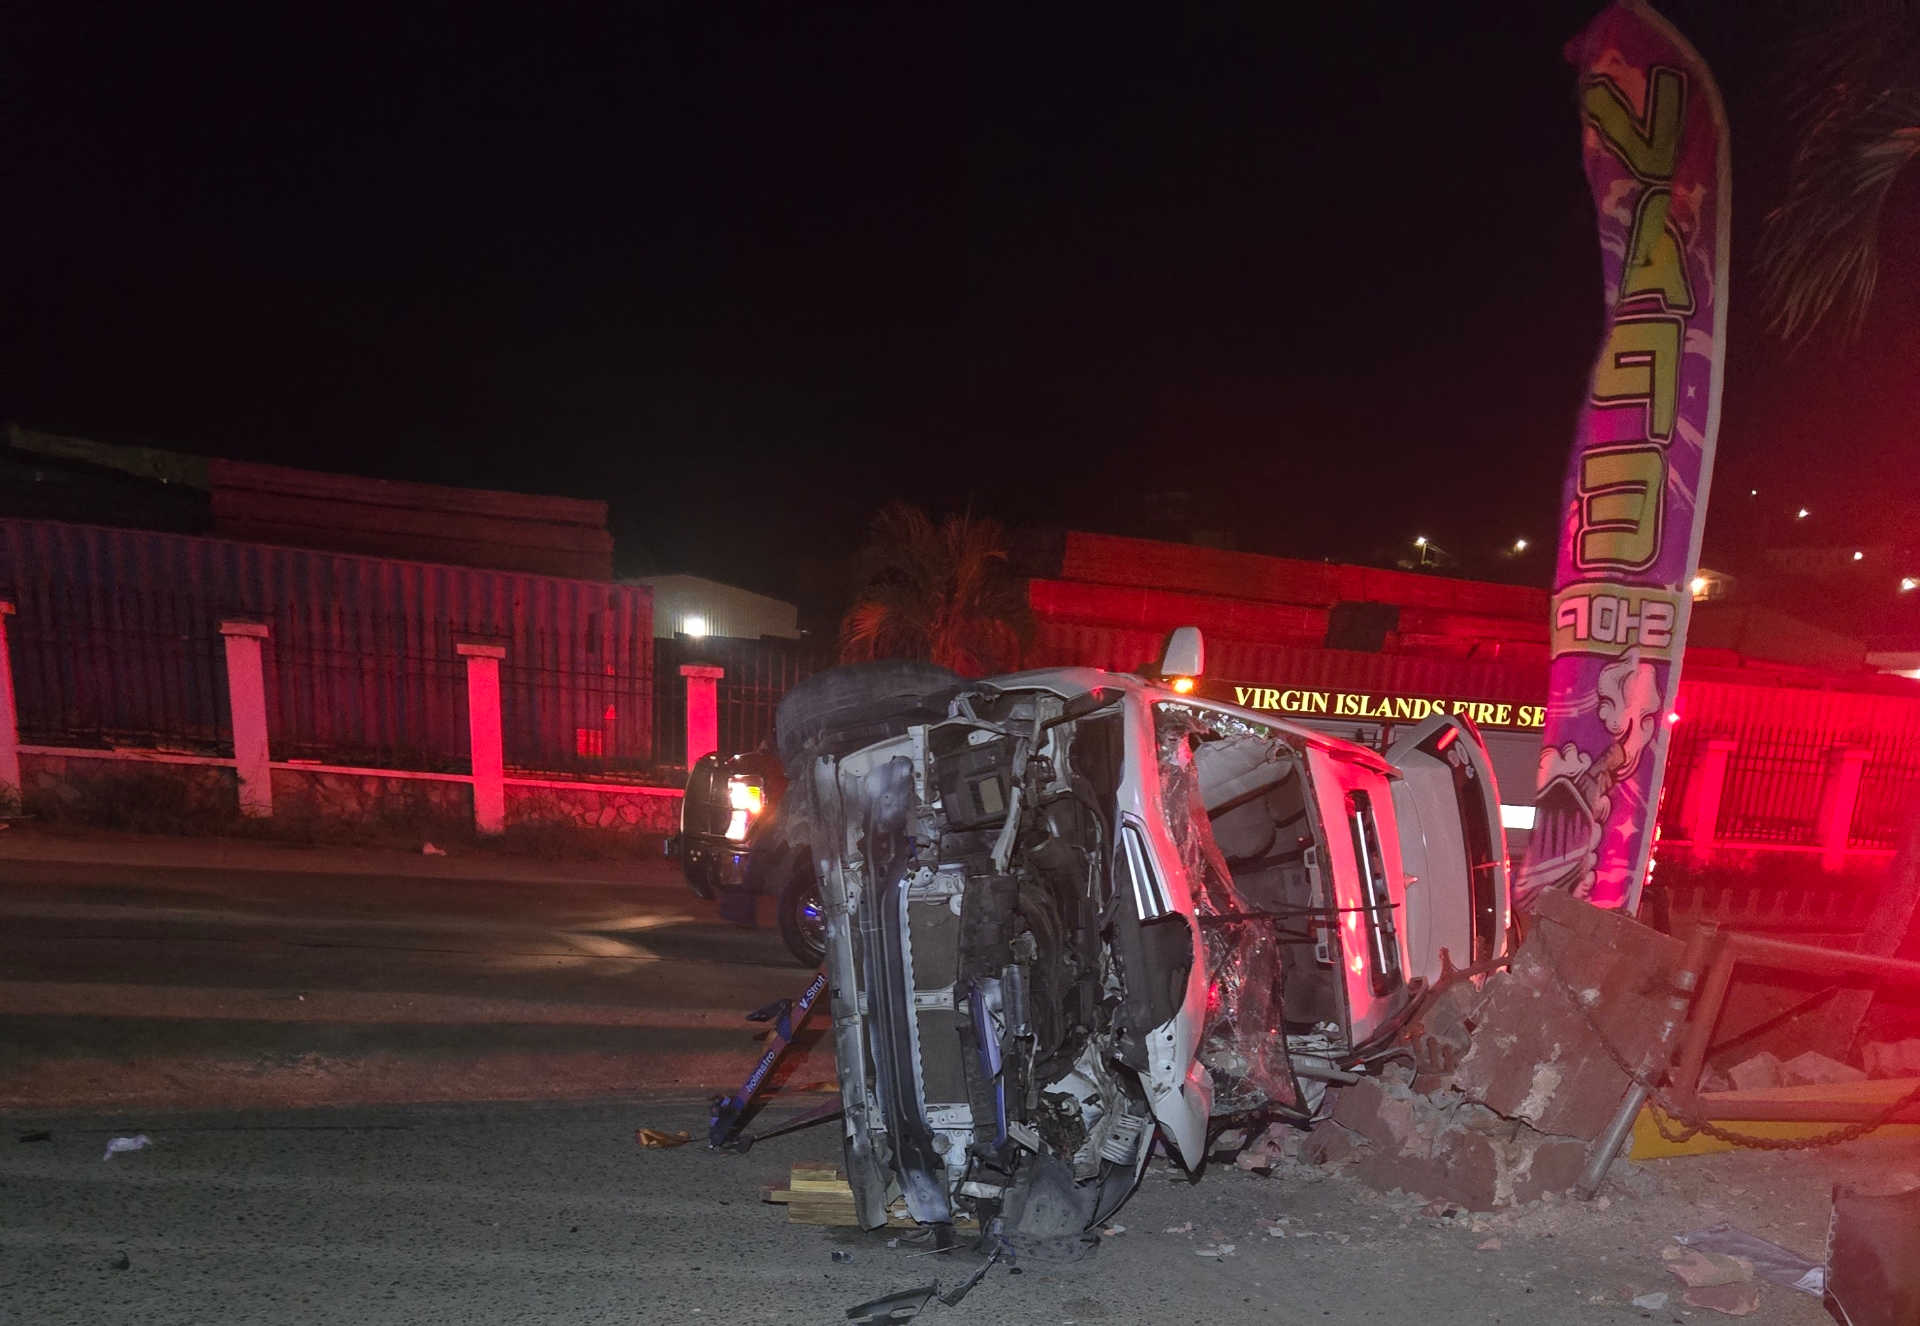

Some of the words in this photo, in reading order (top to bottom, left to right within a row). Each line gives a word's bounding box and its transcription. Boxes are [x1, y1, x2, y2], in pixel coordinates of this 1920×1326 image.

[1234, 686, 1330, 714] VIRGIN
[1335, 693, 1446, 720] ISLANDS
[1453, 701, 1512, 727] FIRE
